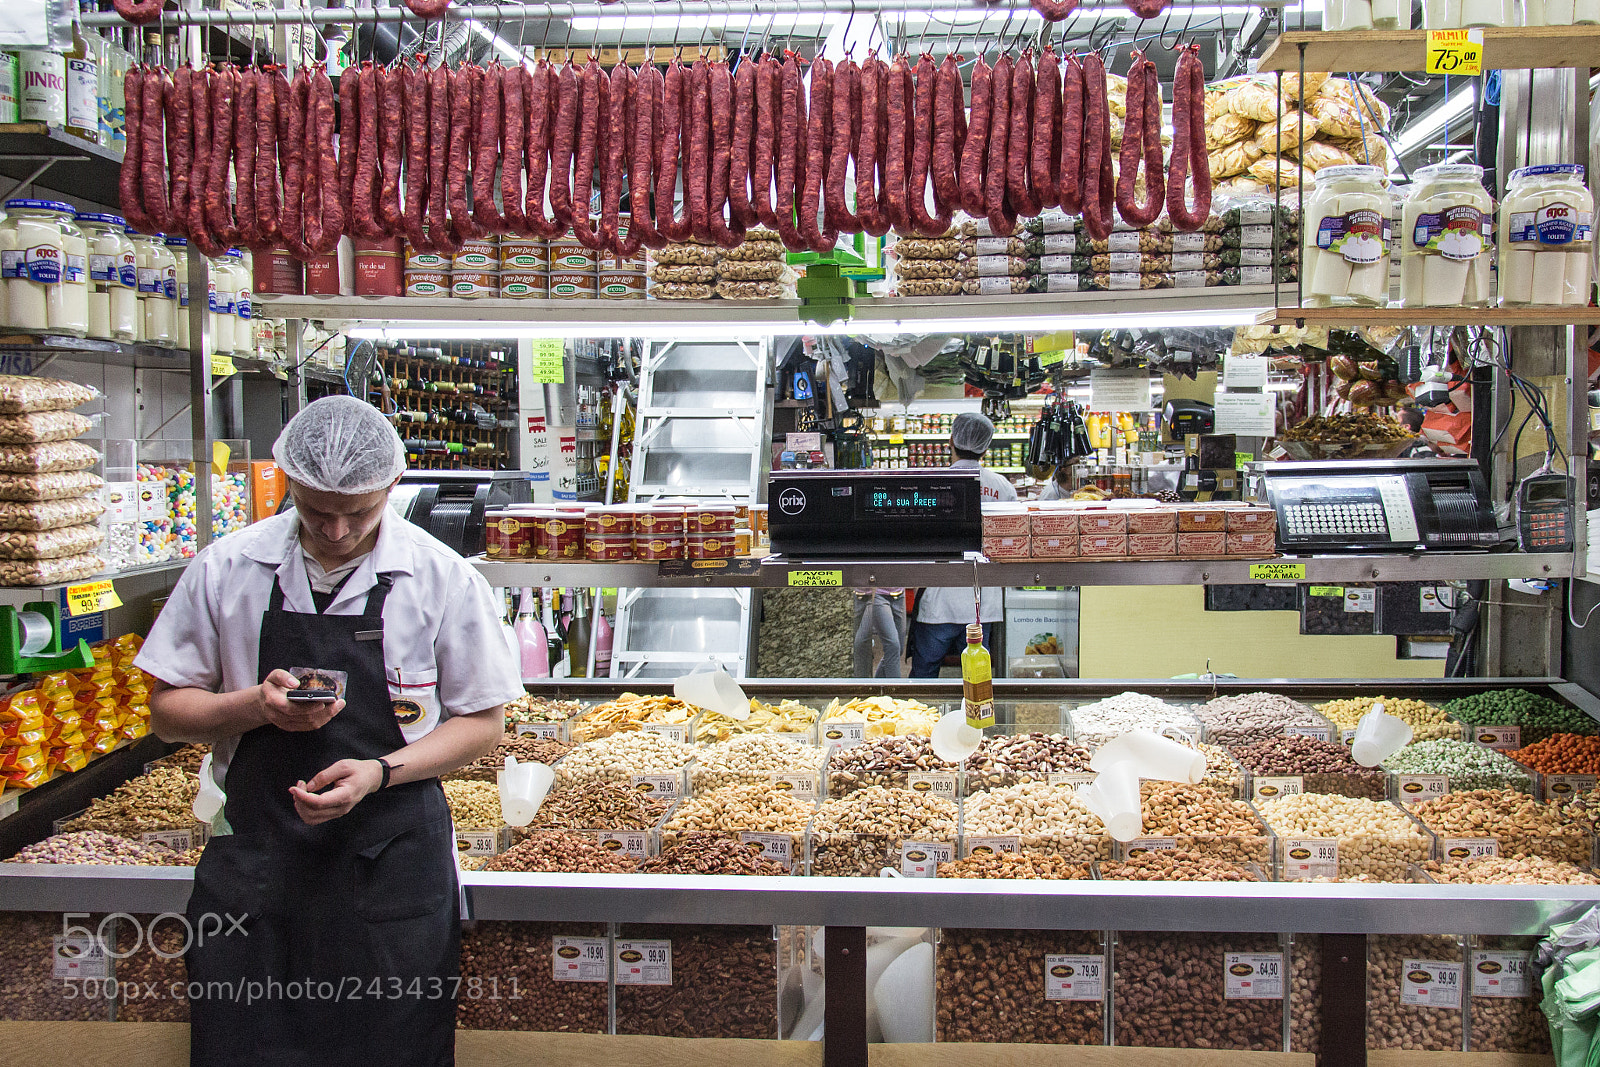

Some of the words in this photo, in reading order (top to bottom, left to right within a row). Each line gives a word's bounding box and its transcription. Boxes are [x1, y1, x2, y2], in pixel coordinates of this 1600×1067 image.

[25, 70, 65, 92] JINRO
[1546, 208, 1569, 219] AJOS
[36, 249, 58, 259] AJOS
[781, 495, 804, 508] prix
[69, 615, 103, 632] EXPRESS
[932, 781, 953, 793] 109,90
[627, 840, 643, 852] 69,90
[587, 946, 604, 960] 19,90
[649, 950, 666, 963] 99,90
[1082, 965, 1099, 979] 79,90
[1260, 962, 1277, 977] 64,90
[1508, 961, 1527, 976] 64,90
[1438, 971, 1456, 985] 99,90
